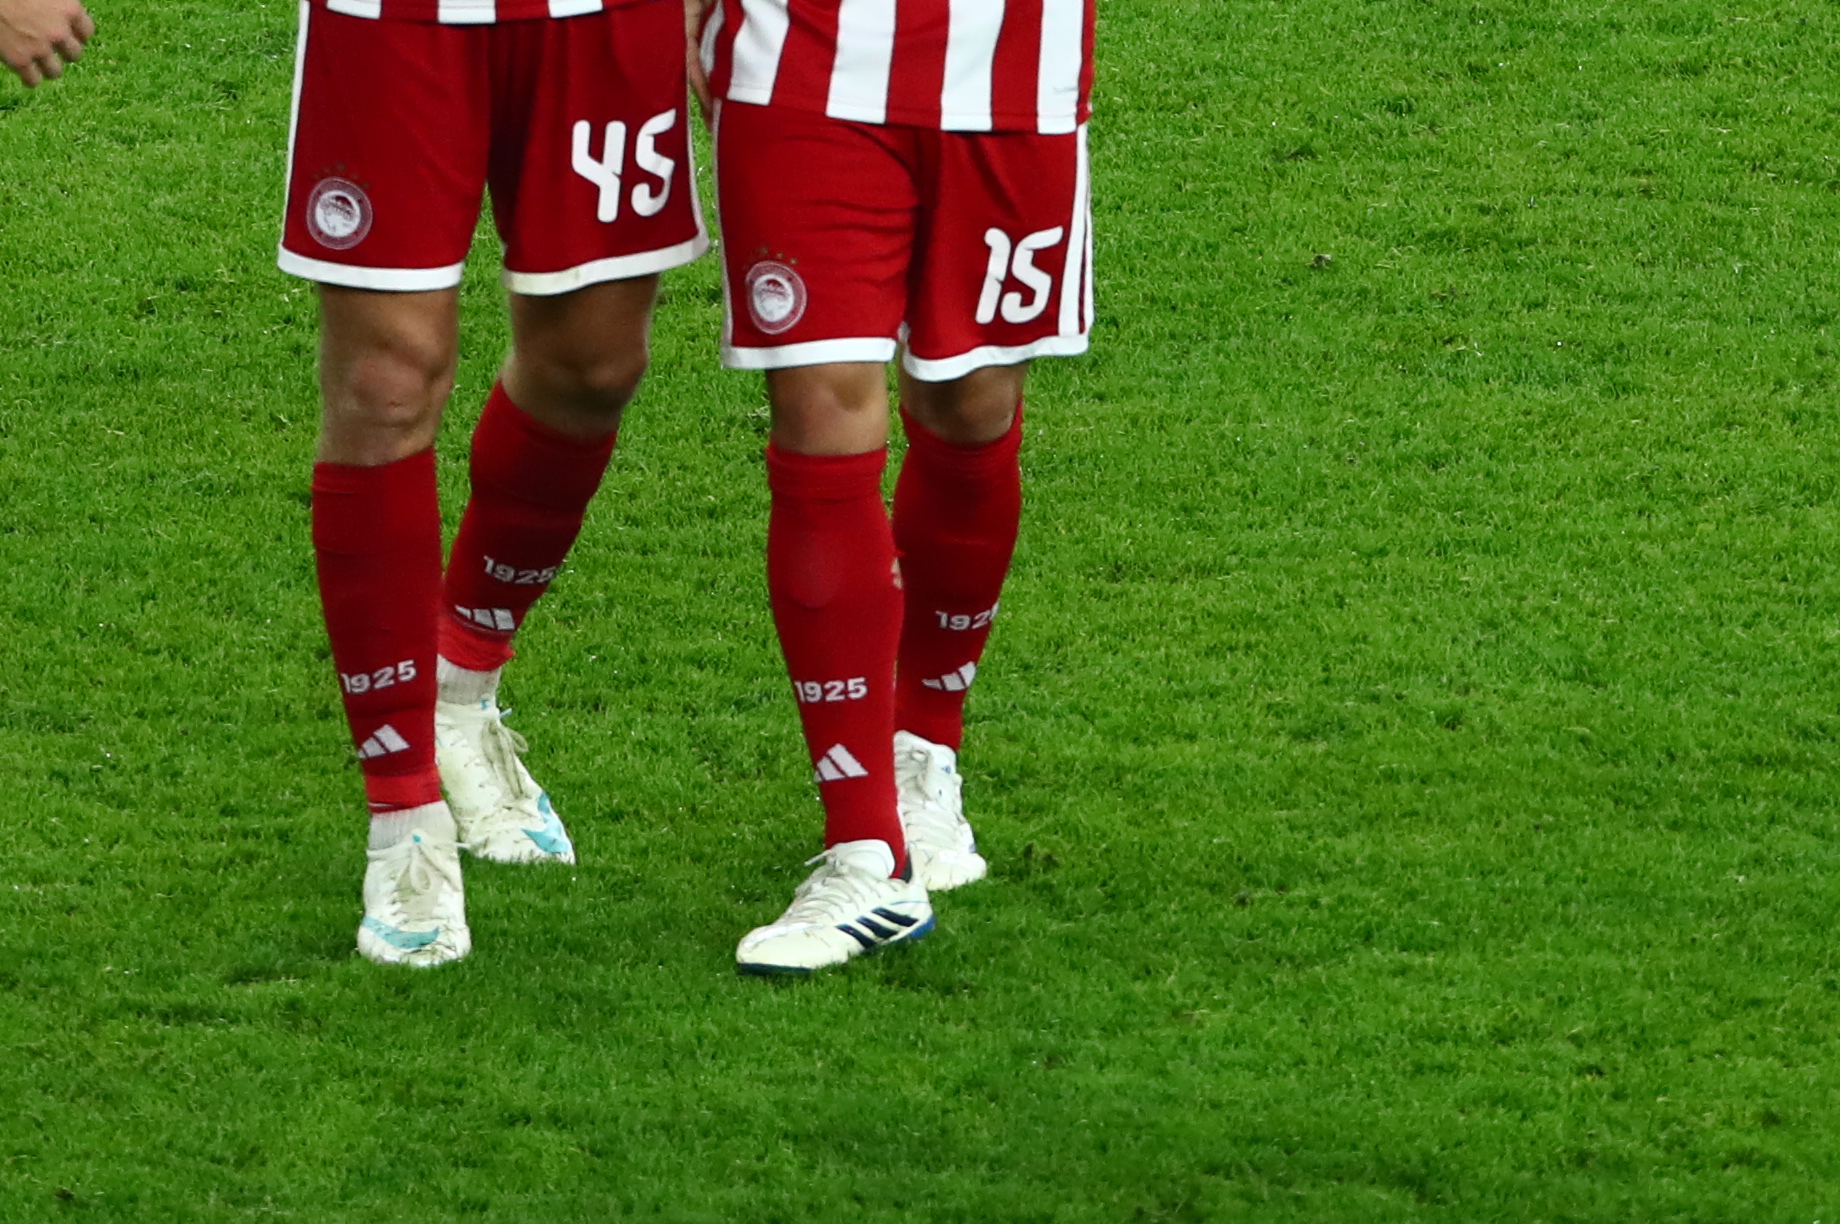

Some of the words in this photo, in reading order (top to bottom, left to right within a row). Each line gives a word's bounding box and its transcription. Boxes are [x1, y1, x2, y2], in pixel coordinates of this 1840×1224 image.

[572, 108, 676, 223] 45
[975, 226, 1064, 324] 15
[483, 555, 556, 584] 1925
[340, 660, 416, 695] 1925
[794, 677, 868, 703] 1925
